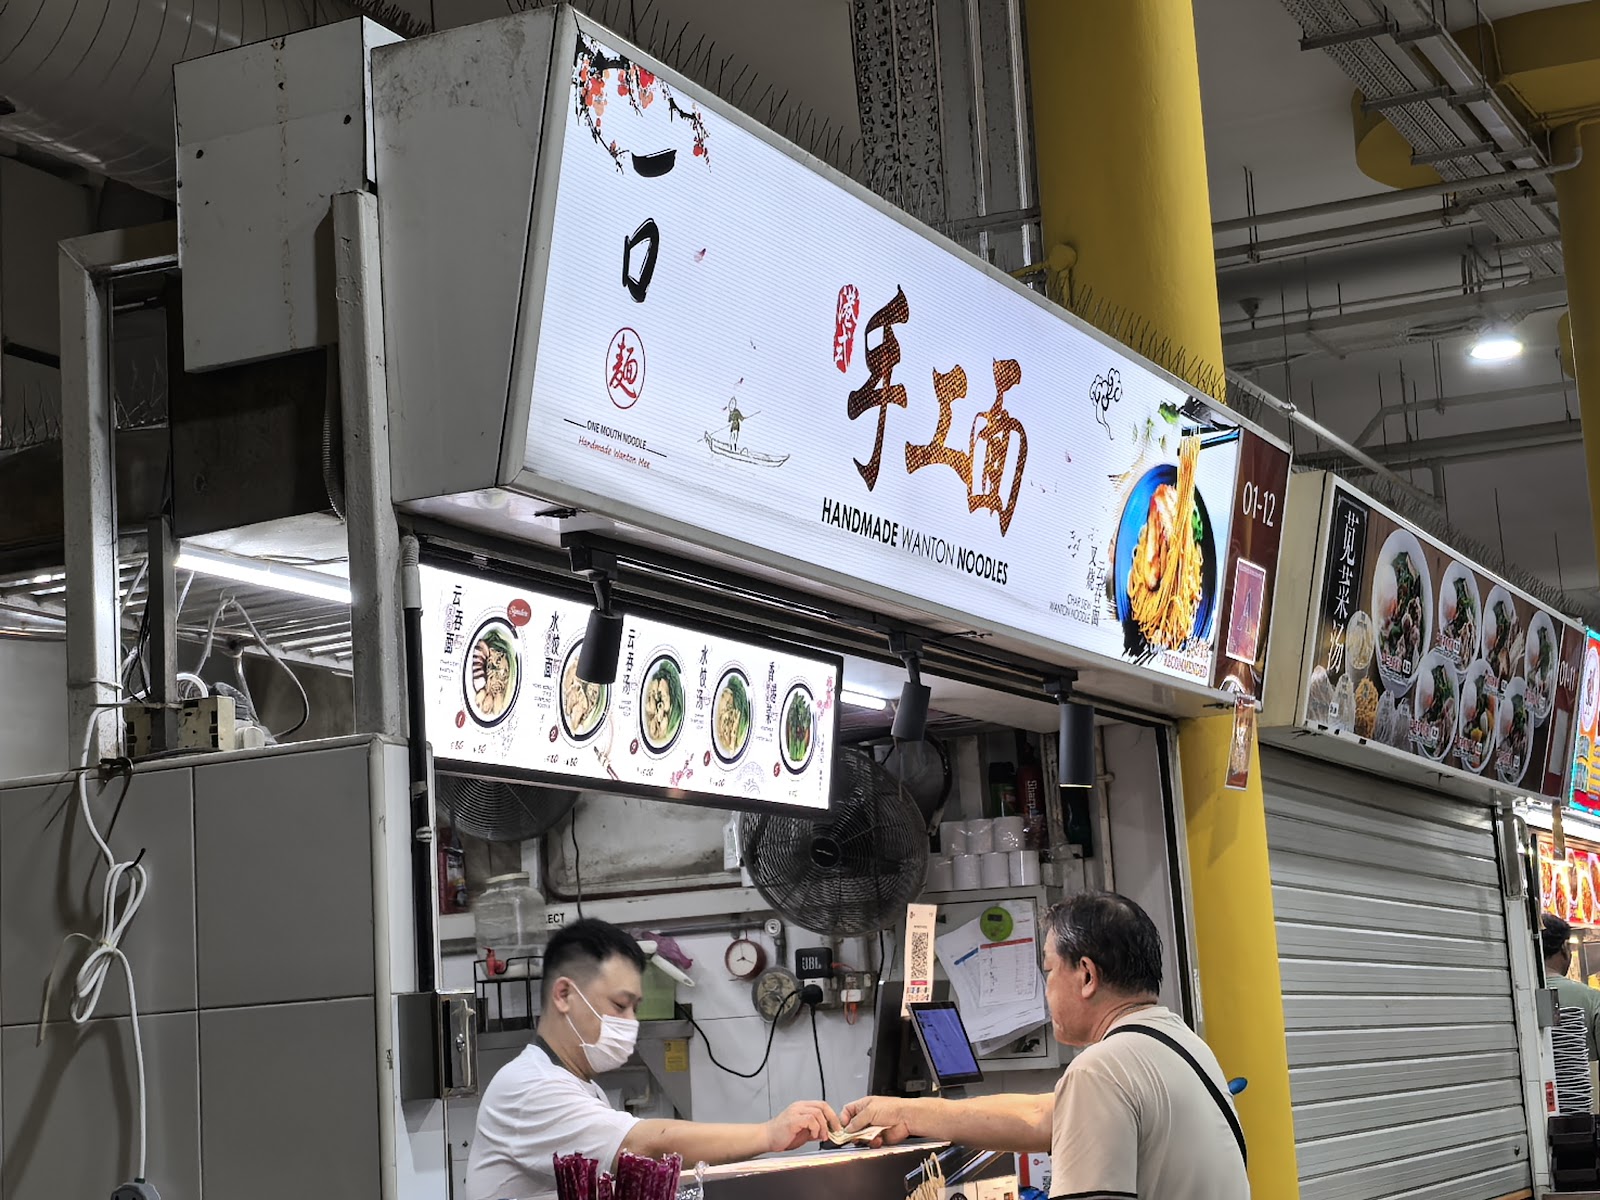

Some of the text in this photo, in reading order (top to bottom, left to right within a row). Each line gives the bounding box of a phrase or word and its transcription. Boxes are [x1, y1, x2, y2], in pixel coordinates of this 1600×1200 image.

[587, 420, 646, 450] ONE MOUTH NOODLE
[578, 436, 612, 456] Handmade
[638, 457, 650, 469] Mee
[1242, 481, 1275, 527] 01-12
[821, 497, 1008, 586] HANDMADE WANTON NOODLES
[1559, 661, 1577, 691] 01-11
[802, 957, 821, 970] JBL
